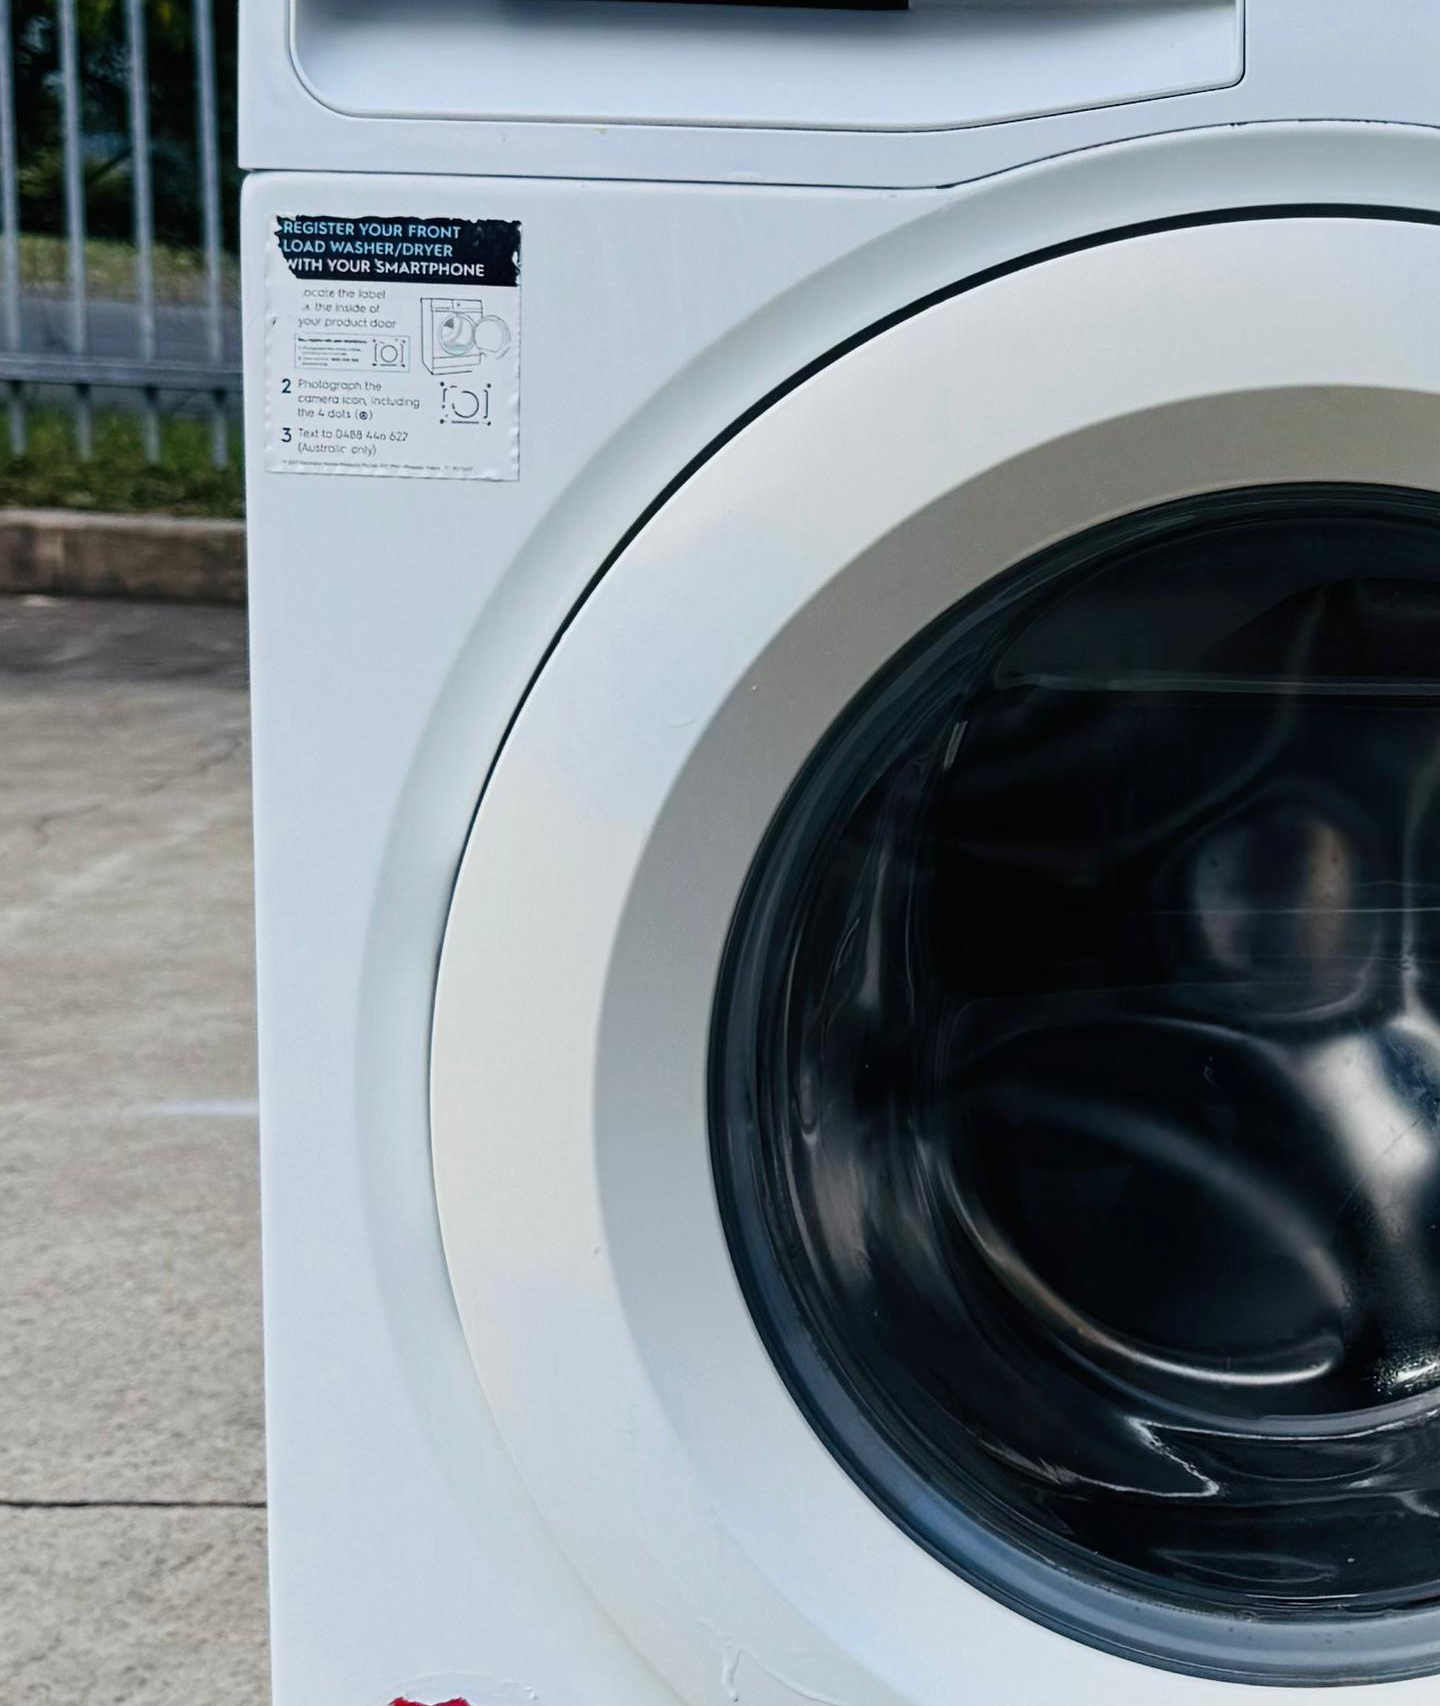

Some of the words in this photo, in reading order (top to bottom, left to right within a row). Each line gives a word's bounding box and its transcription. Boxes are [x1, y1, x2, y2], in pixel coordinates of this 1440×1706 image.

[283, 220, 355, 236] REGISTER
[360, 222, 403, 237] YOUR
[408, 224, 462, 239] FRONT
[283, 239, 326, 254] LOAD
[330, 240, 453, 257] WASHER/DRYER
[328, 259, 371, 273] YOUR
[375, 258, 485, 277] SMARTPHONE
[281, 378, 292, 394] 2
[281, 427, 292, 443] 3
